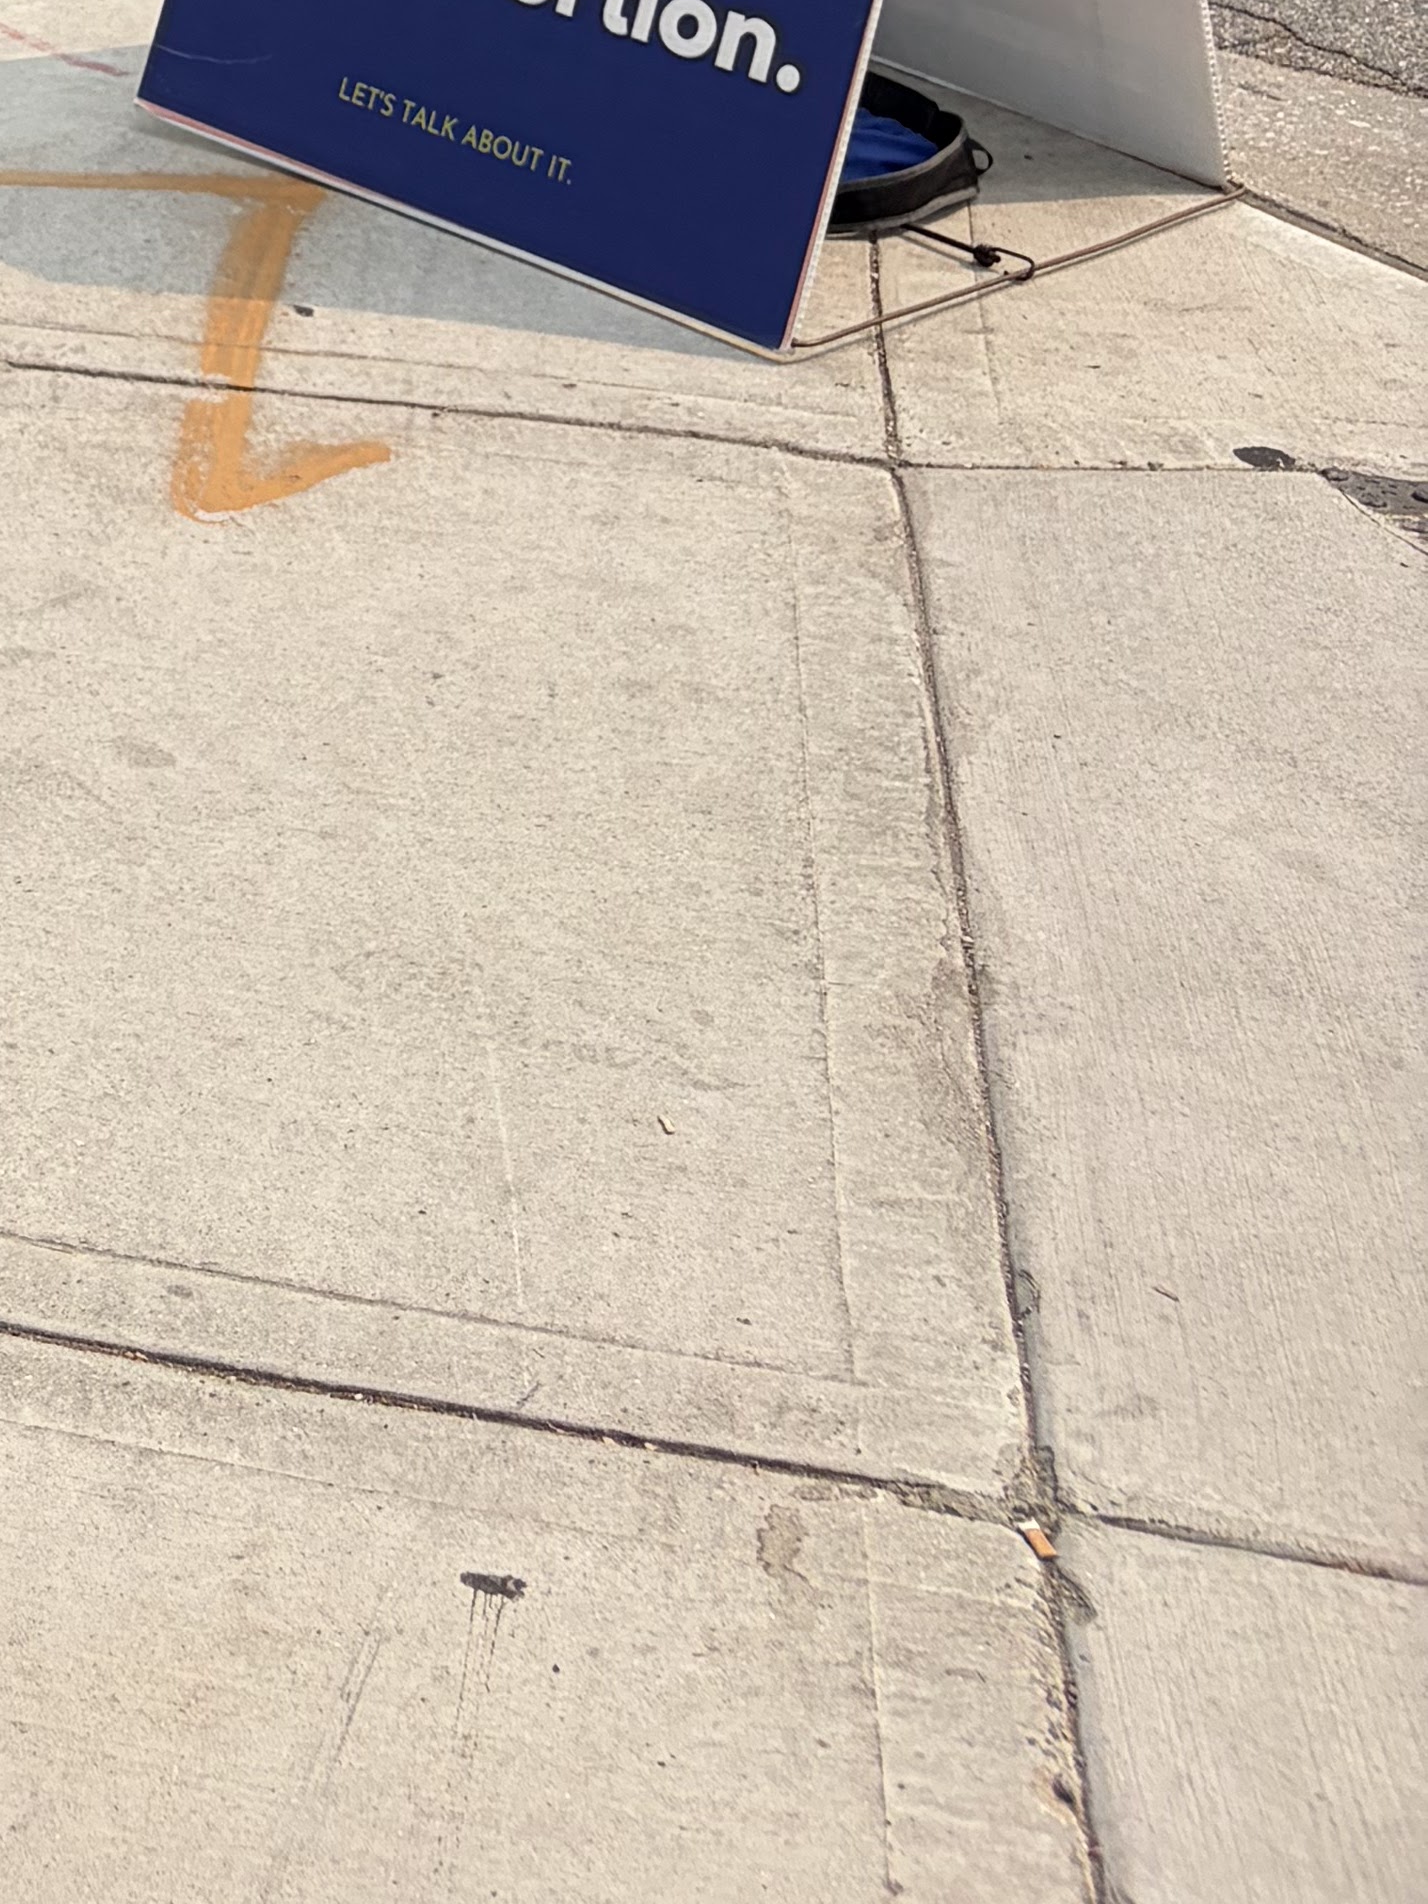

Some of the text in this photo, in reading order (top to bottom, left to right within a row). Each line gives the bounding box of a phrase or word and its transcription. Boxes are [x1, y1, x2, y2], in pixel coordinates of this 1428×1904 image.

[338, 76, 573, 185] LET'S TALK ABOUT IT.
